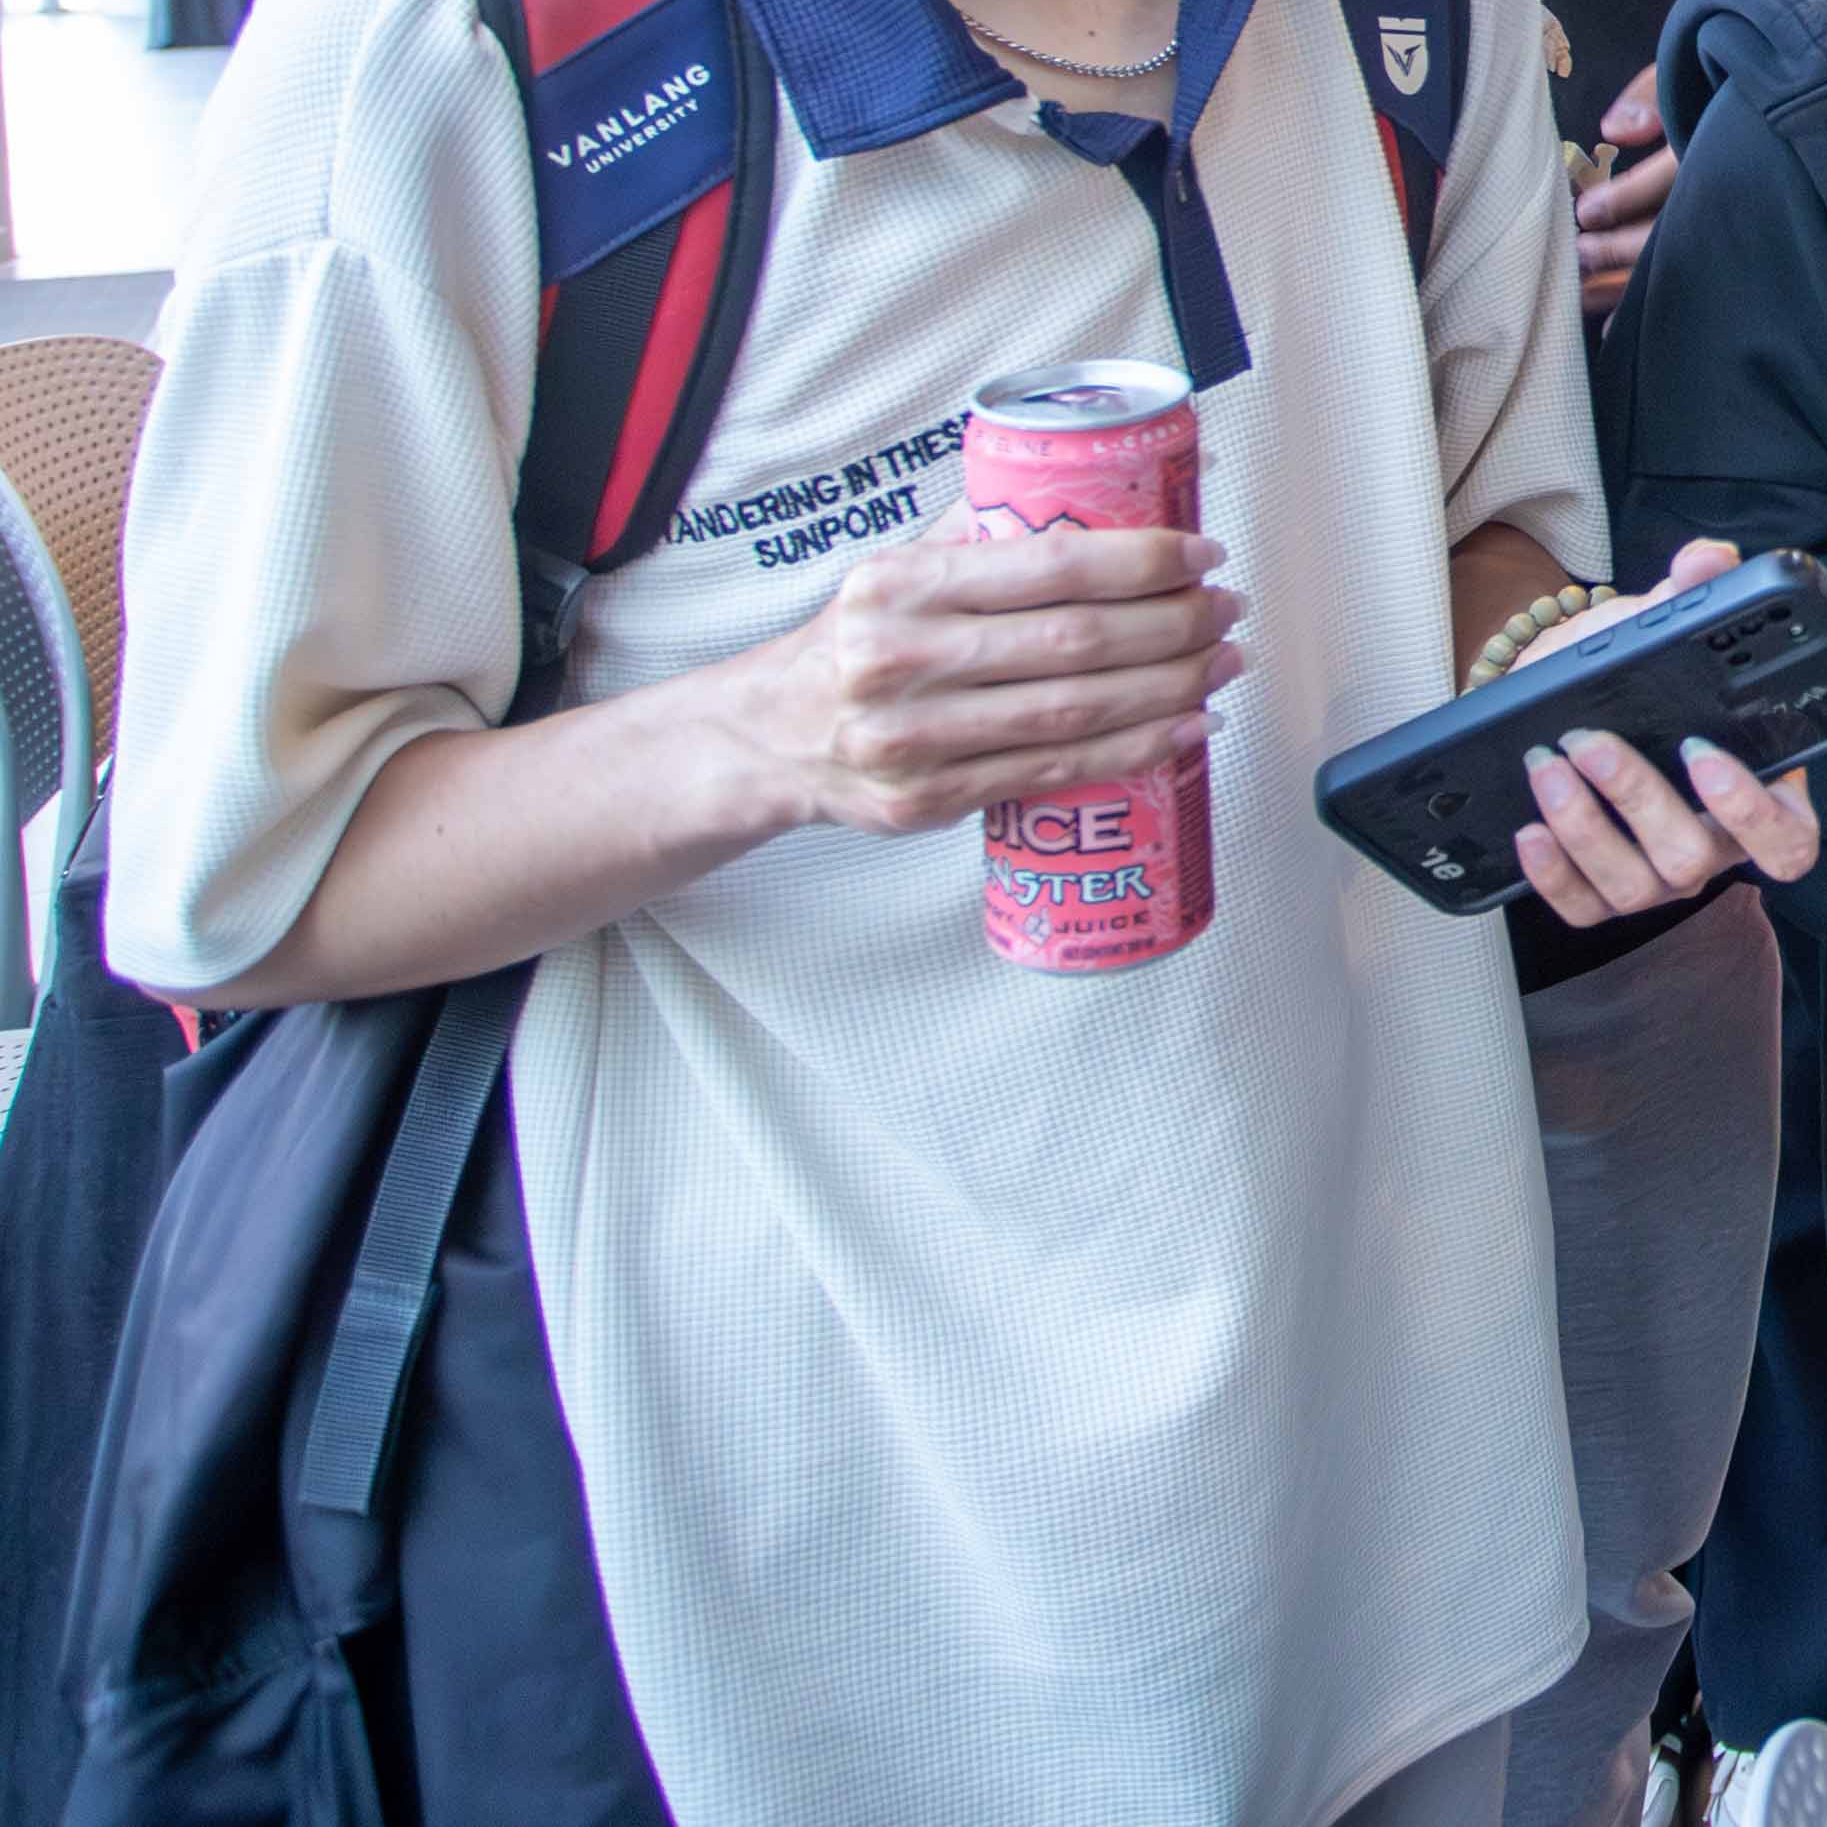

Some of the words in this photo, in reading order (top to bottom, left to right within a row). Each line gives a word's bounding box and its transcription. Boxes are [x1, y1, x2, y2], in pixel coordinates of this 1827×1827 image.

[547, 64, 712, 168] VANLANG
[585, 98, 700, 174] UNIVERSITY
[841, 456, 880, 497] IN
[878, 410, 973, 479] THES
[753, 484, 922, 569] SUNPOINT
[1053, 910, 1151, 935] JUICE
